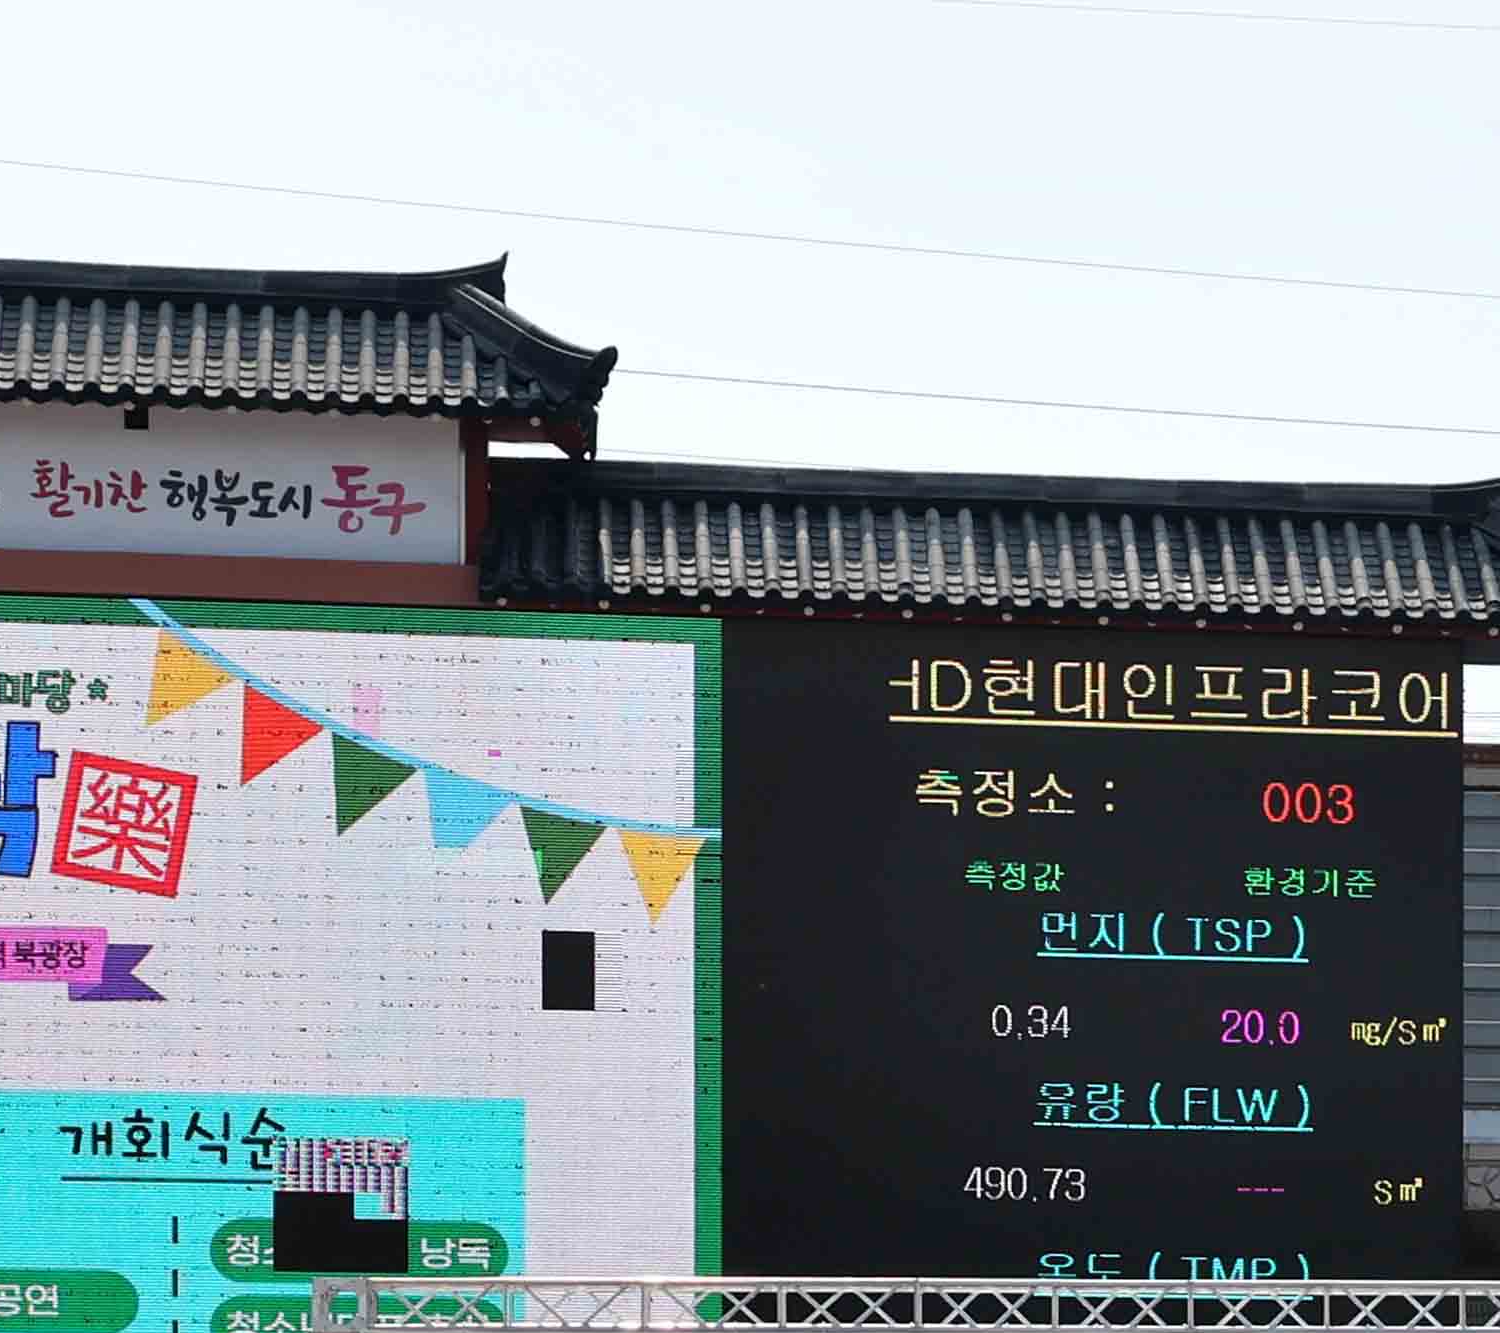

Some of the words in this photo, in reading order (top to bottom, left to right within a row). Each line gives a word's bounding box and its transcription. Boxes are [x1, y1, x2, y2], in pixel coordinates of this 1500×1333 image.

[29, 459, 149, 518] 활기찬
[160, 471, 314, 528] 행복도시
[322, 465, 427, 535] 동구
[915, 769, 1076, 818] 측정소
[1262, 781, 1357, 825] 003
[71, 770, 177, 879] 樂
[965, 861, 1066, 894] 측정값
[1243, 866, 1379, 900] 환경기준
[1041, 911, 1126, 953] 먼지
[13, 940, 88, 971] 북광장
[991, 1004, 1072, 1040] 0.34
[1220, 1010, 1301, 1046] 20.0
[1037, 1083, 1125, 1123] 유량
[963, 1166, 1087, 1203] 490.73
[421, 1237, 491, 1269] 낭독
